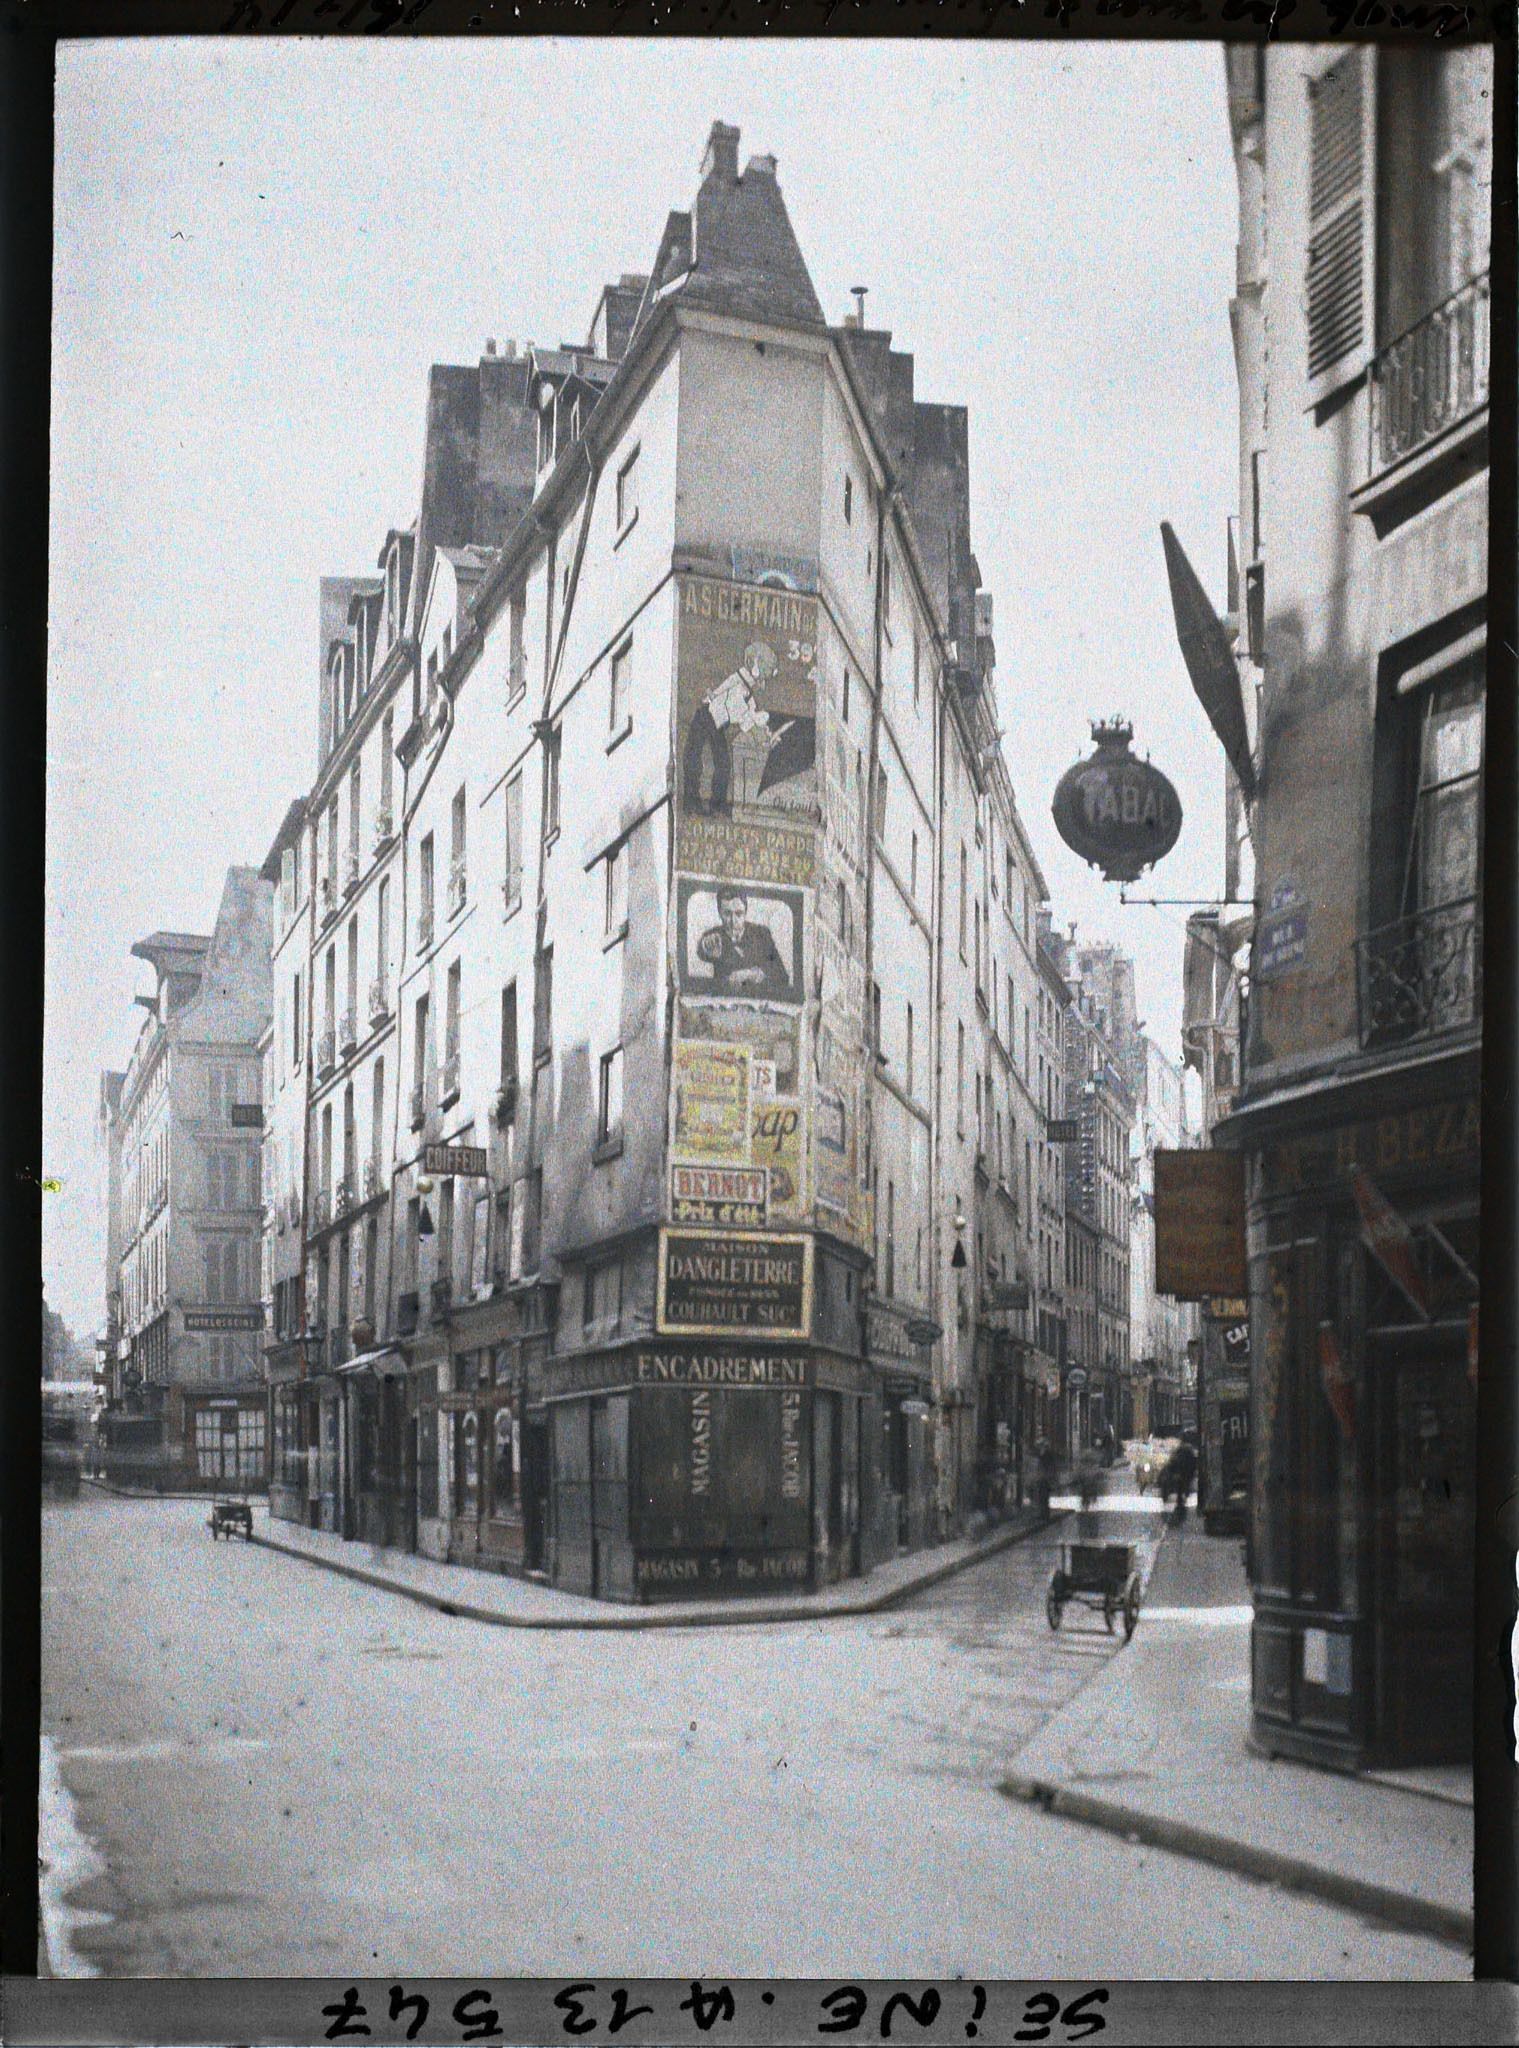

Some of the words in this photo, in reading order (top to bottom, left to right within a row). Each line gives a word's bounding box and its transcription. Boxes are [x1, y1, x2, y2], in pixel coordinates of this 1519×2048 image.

[717, 586, 802, 631] GERMAIN
[426, 1146, 485, 1174] COIFFEUR
[702, 1241, 770, 1256] MAISON
[669, 1255, 800, 1286] DANGLETERRE
[637, 1354, 809, 1384] ENCADREMENT
[691, 1390, 711, 1496] MAGASIN
[321, 1986, 505, 2041] 547
